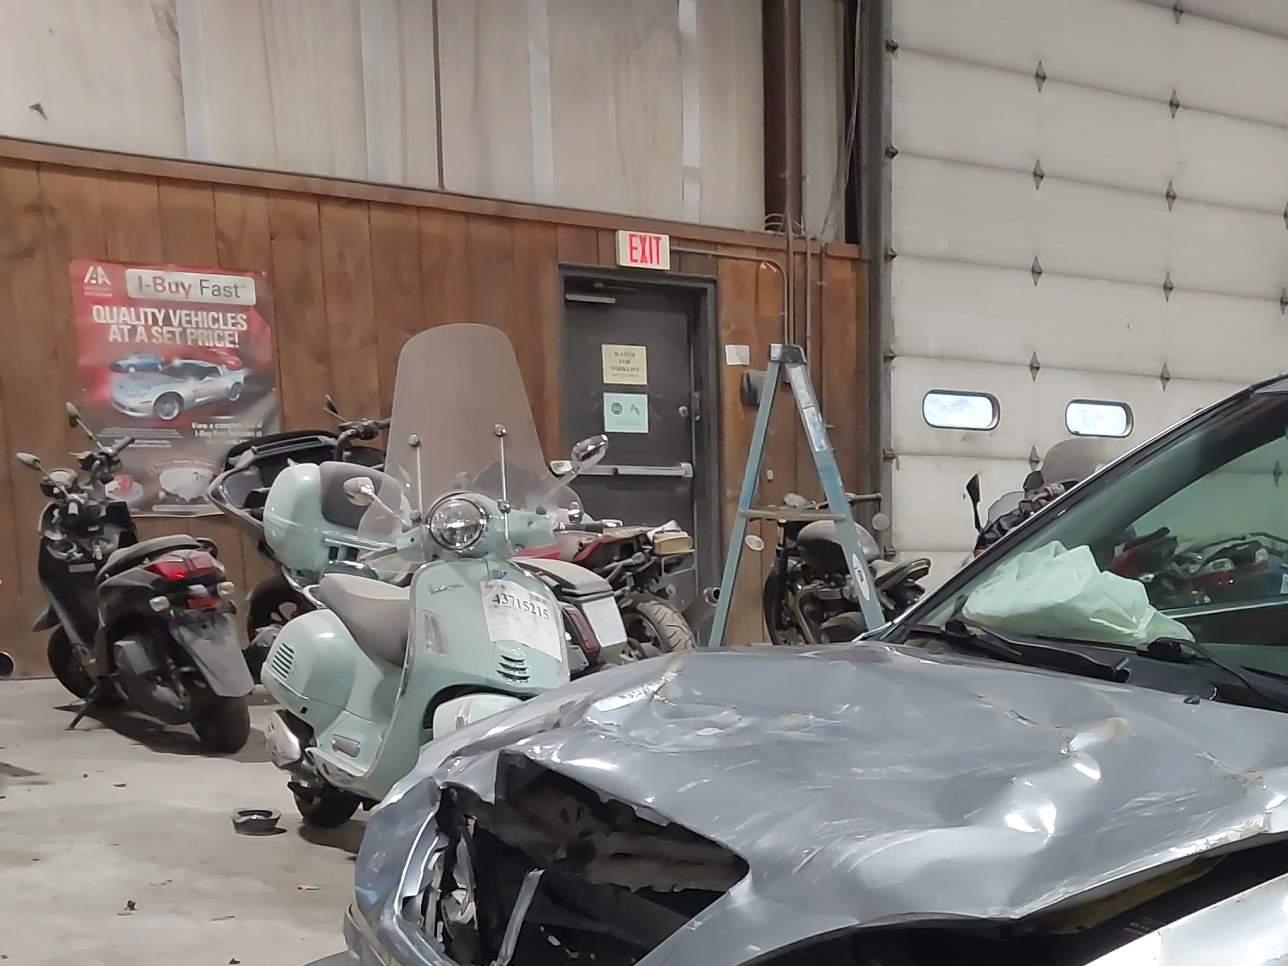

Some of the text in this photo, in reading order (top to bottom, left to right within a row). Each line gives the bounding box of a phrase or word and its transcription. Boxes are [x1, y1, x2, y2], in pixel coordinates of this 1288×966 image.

[629, 233, 662, 266] EXIT
[137, 275, 193, 299] I-Buy
[199, 279, 241, 298] Fast
[92, 304, 248, 331] QUALITY VEHICLES
[108, 325, 240, 348] AT A SET PRICE!
[492, 593, 550, 621] 43715215
